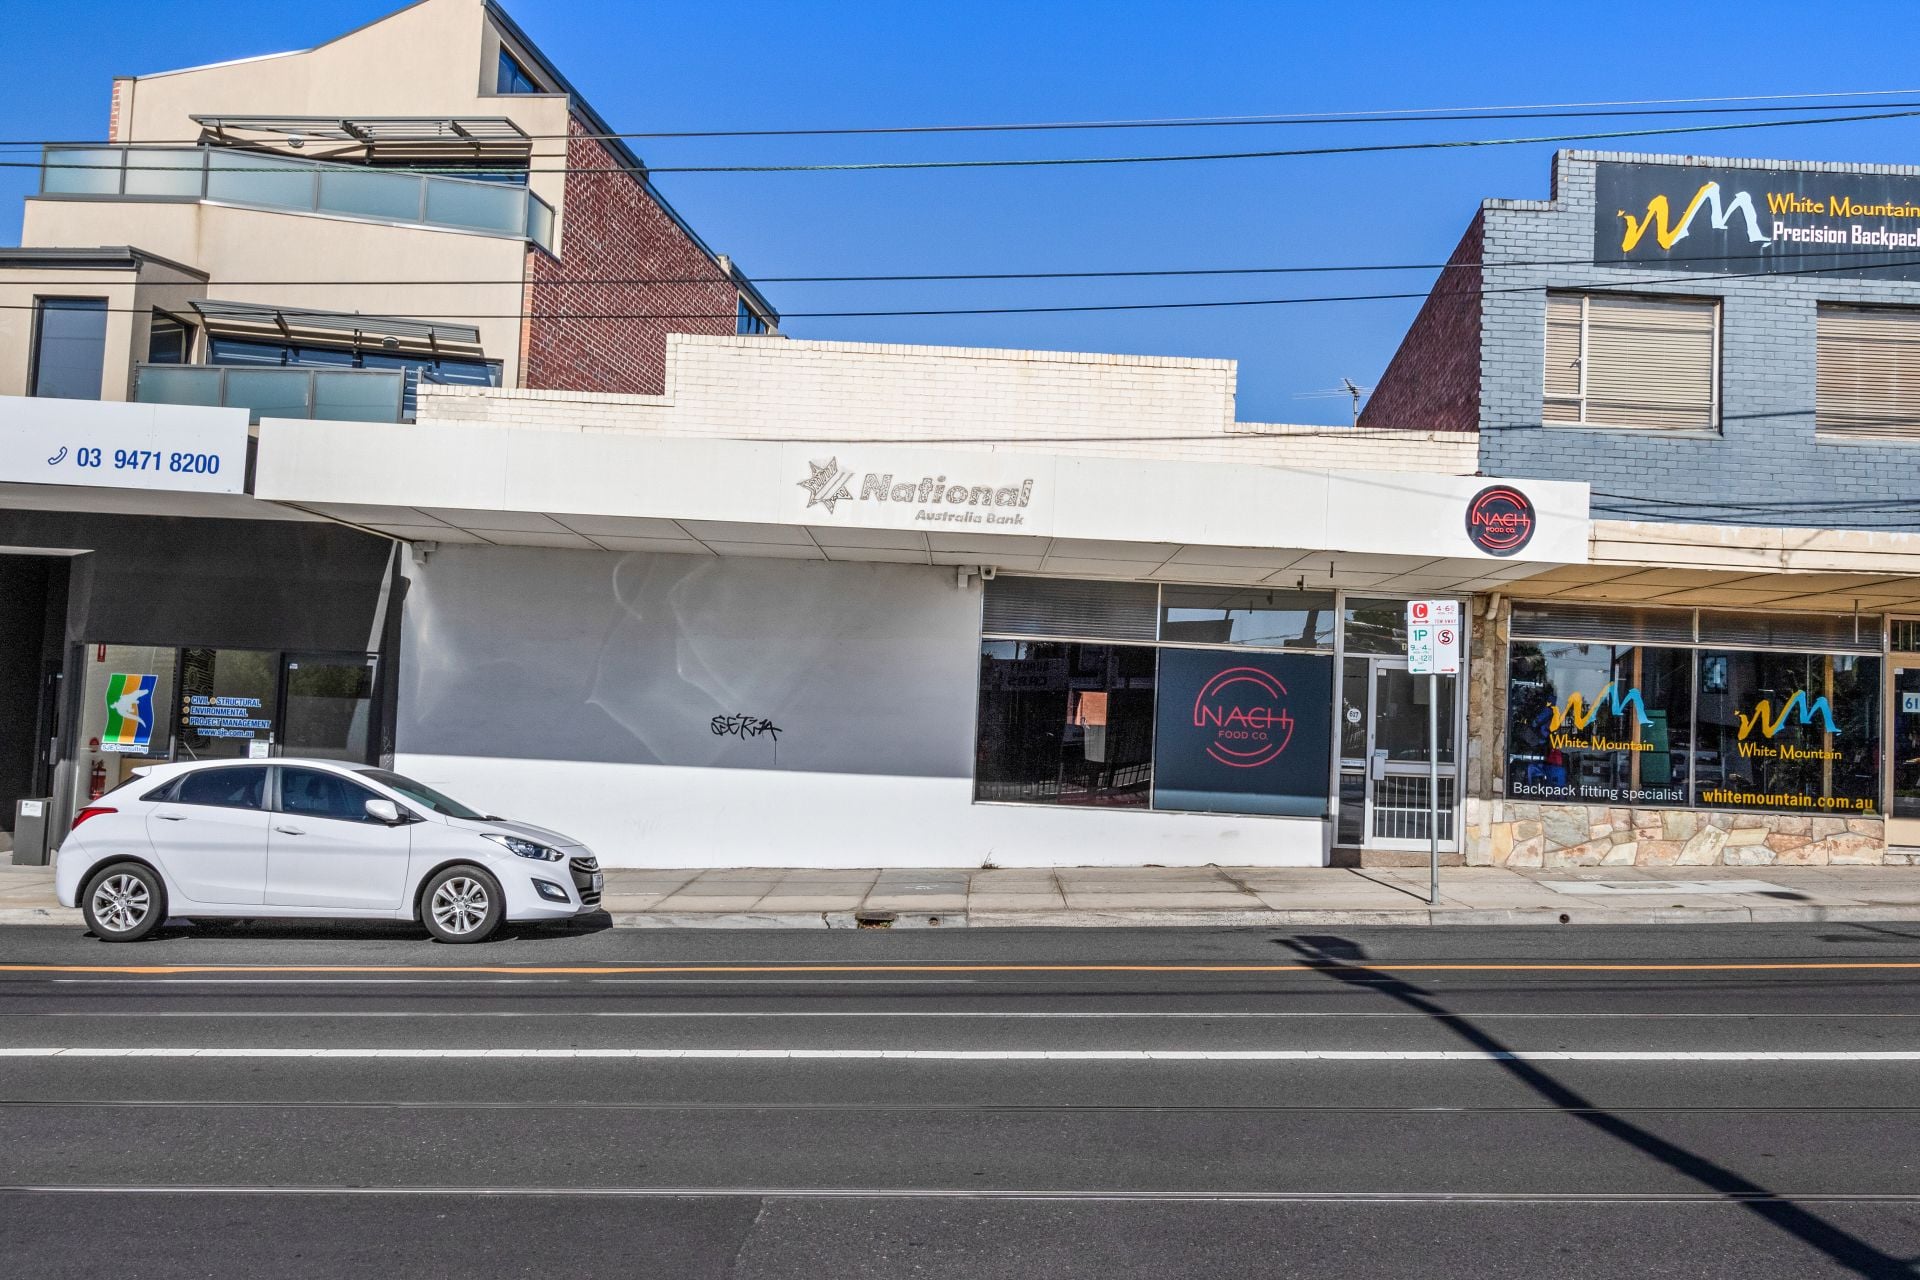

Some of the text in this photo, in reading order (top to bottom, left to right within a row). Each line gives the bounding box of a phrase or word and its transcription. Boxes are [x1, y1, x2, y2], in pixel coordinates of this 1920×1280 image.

[1767, 192, 1920, 218] White Mountain
[1773, 221, 1847, 243] Precision
[77, 447, 220, 474] 03 9471 8200
[860, 473, 1034, 508] National
[915, 509, 1024, 525] Australia Bank
[1476, 512, 1527, 527] NACH
[1413, 629, 1428, 641] 1P
[191, 696, 261, 708] CIVIL STRUCTURAL
[190, 706, 248, 717] ENVIRONMENTAL
[1202, 704, 1288, 730] NACH
[189, 717, 271, 729] PROJECT MANAGEMENT
[1218, 730, 1249, 740] FOOD
[1549, 733, 1654, 752] White Mountain
[1737, 742, 1843, 760] White Mountain
[1513, 781, 1684, 801] Backpack fitting specialist
[1702, 788, 1874, 810] whitemountain.com.au
